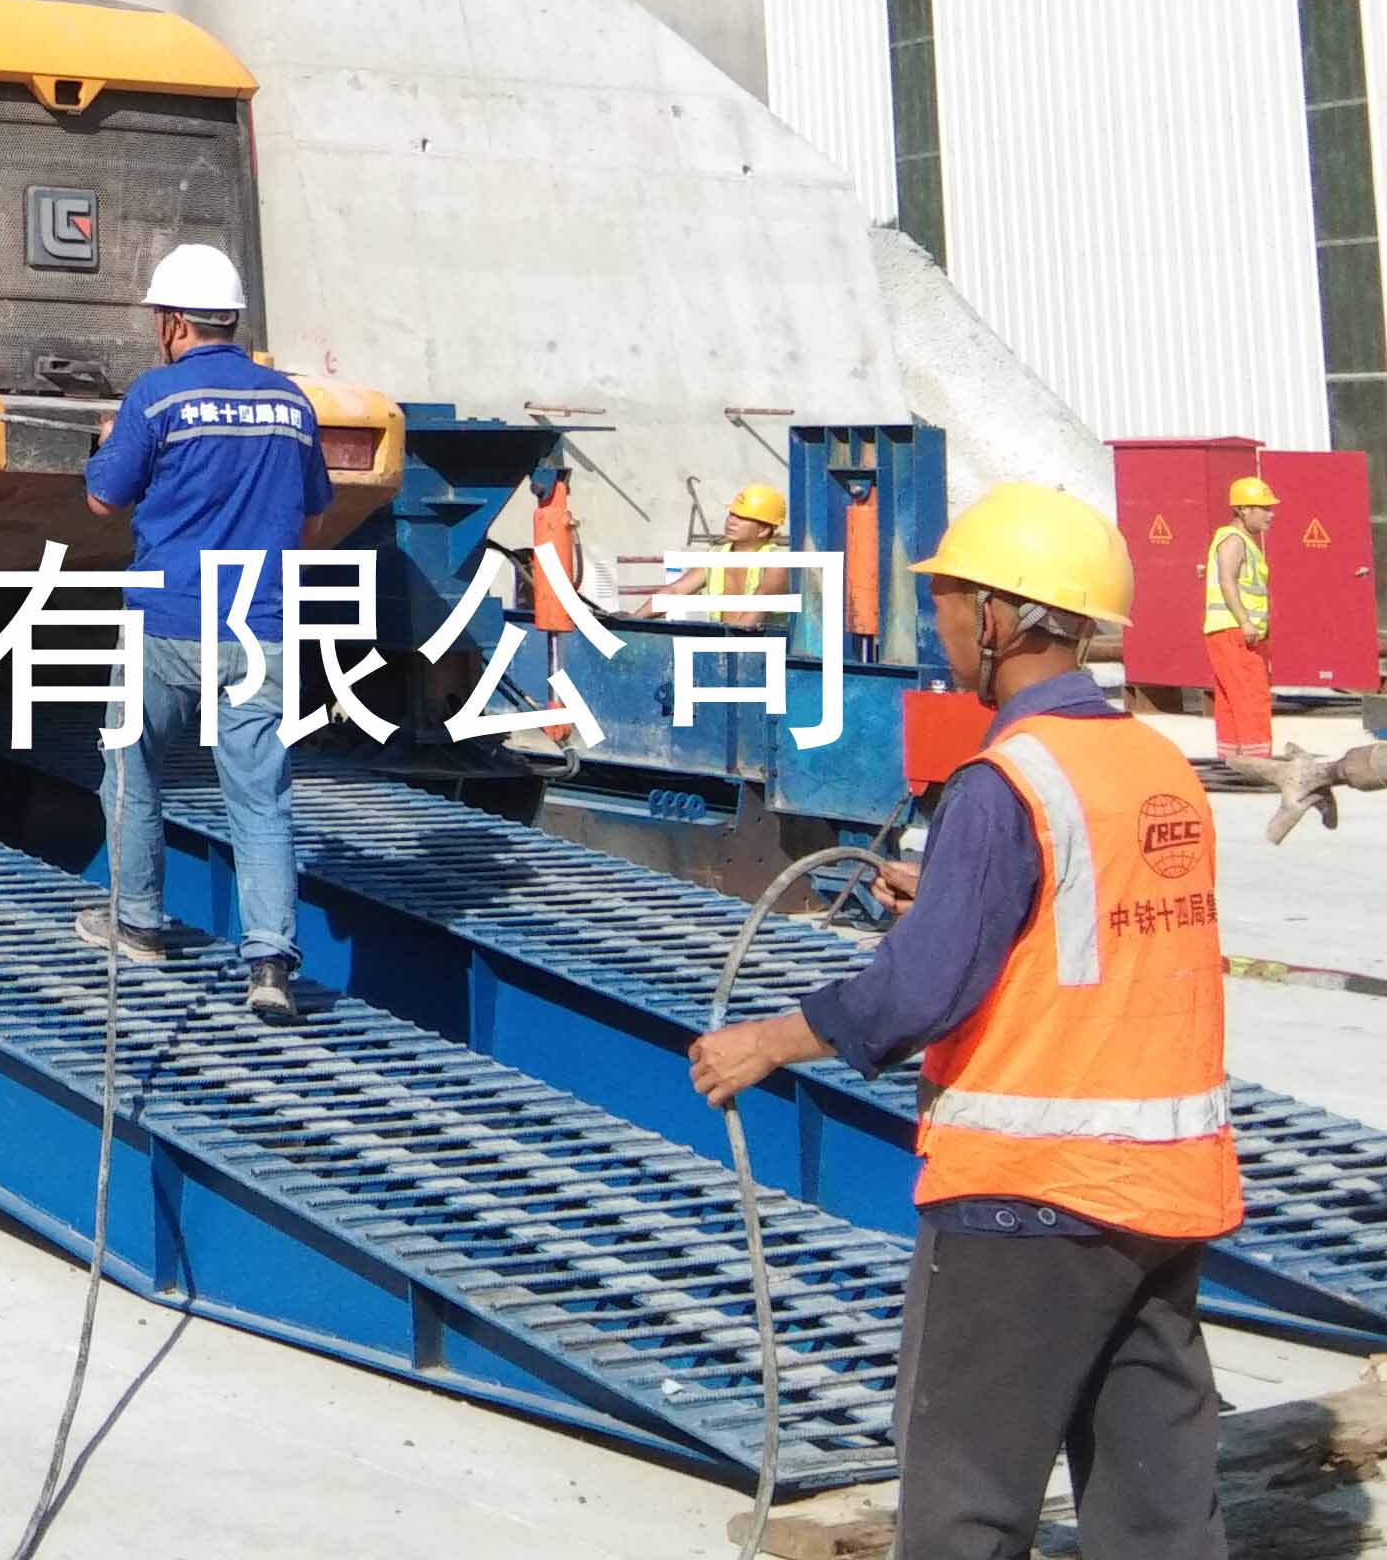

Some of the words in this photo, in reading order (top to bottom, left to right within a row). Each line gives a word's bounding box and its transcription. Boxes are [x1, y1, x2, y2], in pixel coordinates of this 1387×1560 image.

[180, 401, 303, 429] 中铁十四局集团
